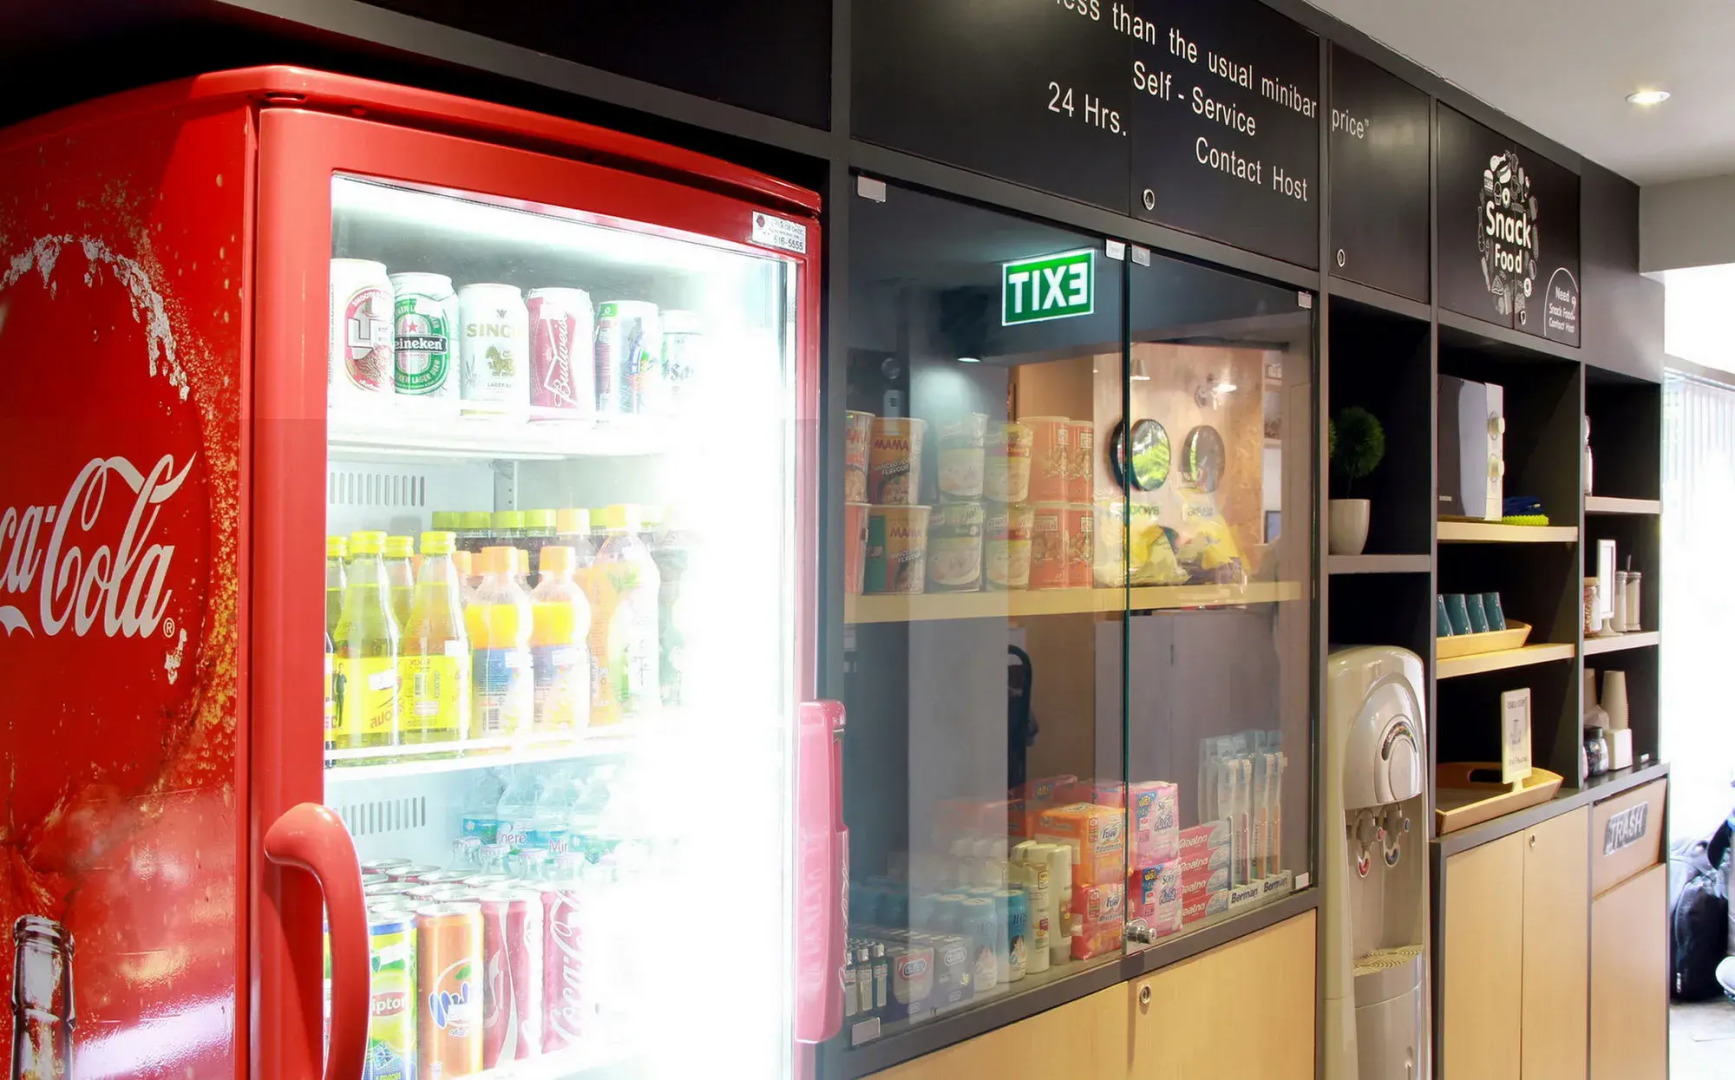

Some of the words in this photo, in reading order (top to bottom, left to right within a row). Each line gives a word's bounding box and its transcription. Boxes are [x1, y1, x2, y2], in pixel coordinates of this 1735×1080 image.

[1057, 0, 1100, 21] ss
[1112, 2, 1156, 46] than
[1169, 27, 1198, 64] the
[1208, 51, 1253, 90] usual
[1261, 76, 1317, 119] minibar
[1133, 60, 1172, 101] Self
[1192, 86, 1256, 136] Service
[1048, 81, 1075, 118] 24
[1085, 93, 1127, 137] Hrs.
[1196, 136, 1261, 185] Contact
[1273, 165, 1307, 202] Host
[1485, 200, 1532, 249] Snack
[1495, 242, 1522, 274] Food
[1555, 286, 1570, 302] Need
[395, 334, 443, 350] eineken
[874, 439, 909, 450] MAMA
[0, 451, 197, 639] ca-Cola
[1609, 808, 1643, 847] TRASH
[1231, 888, 1258, 904] Berman
[371, 996, 408, 1015] ipto
